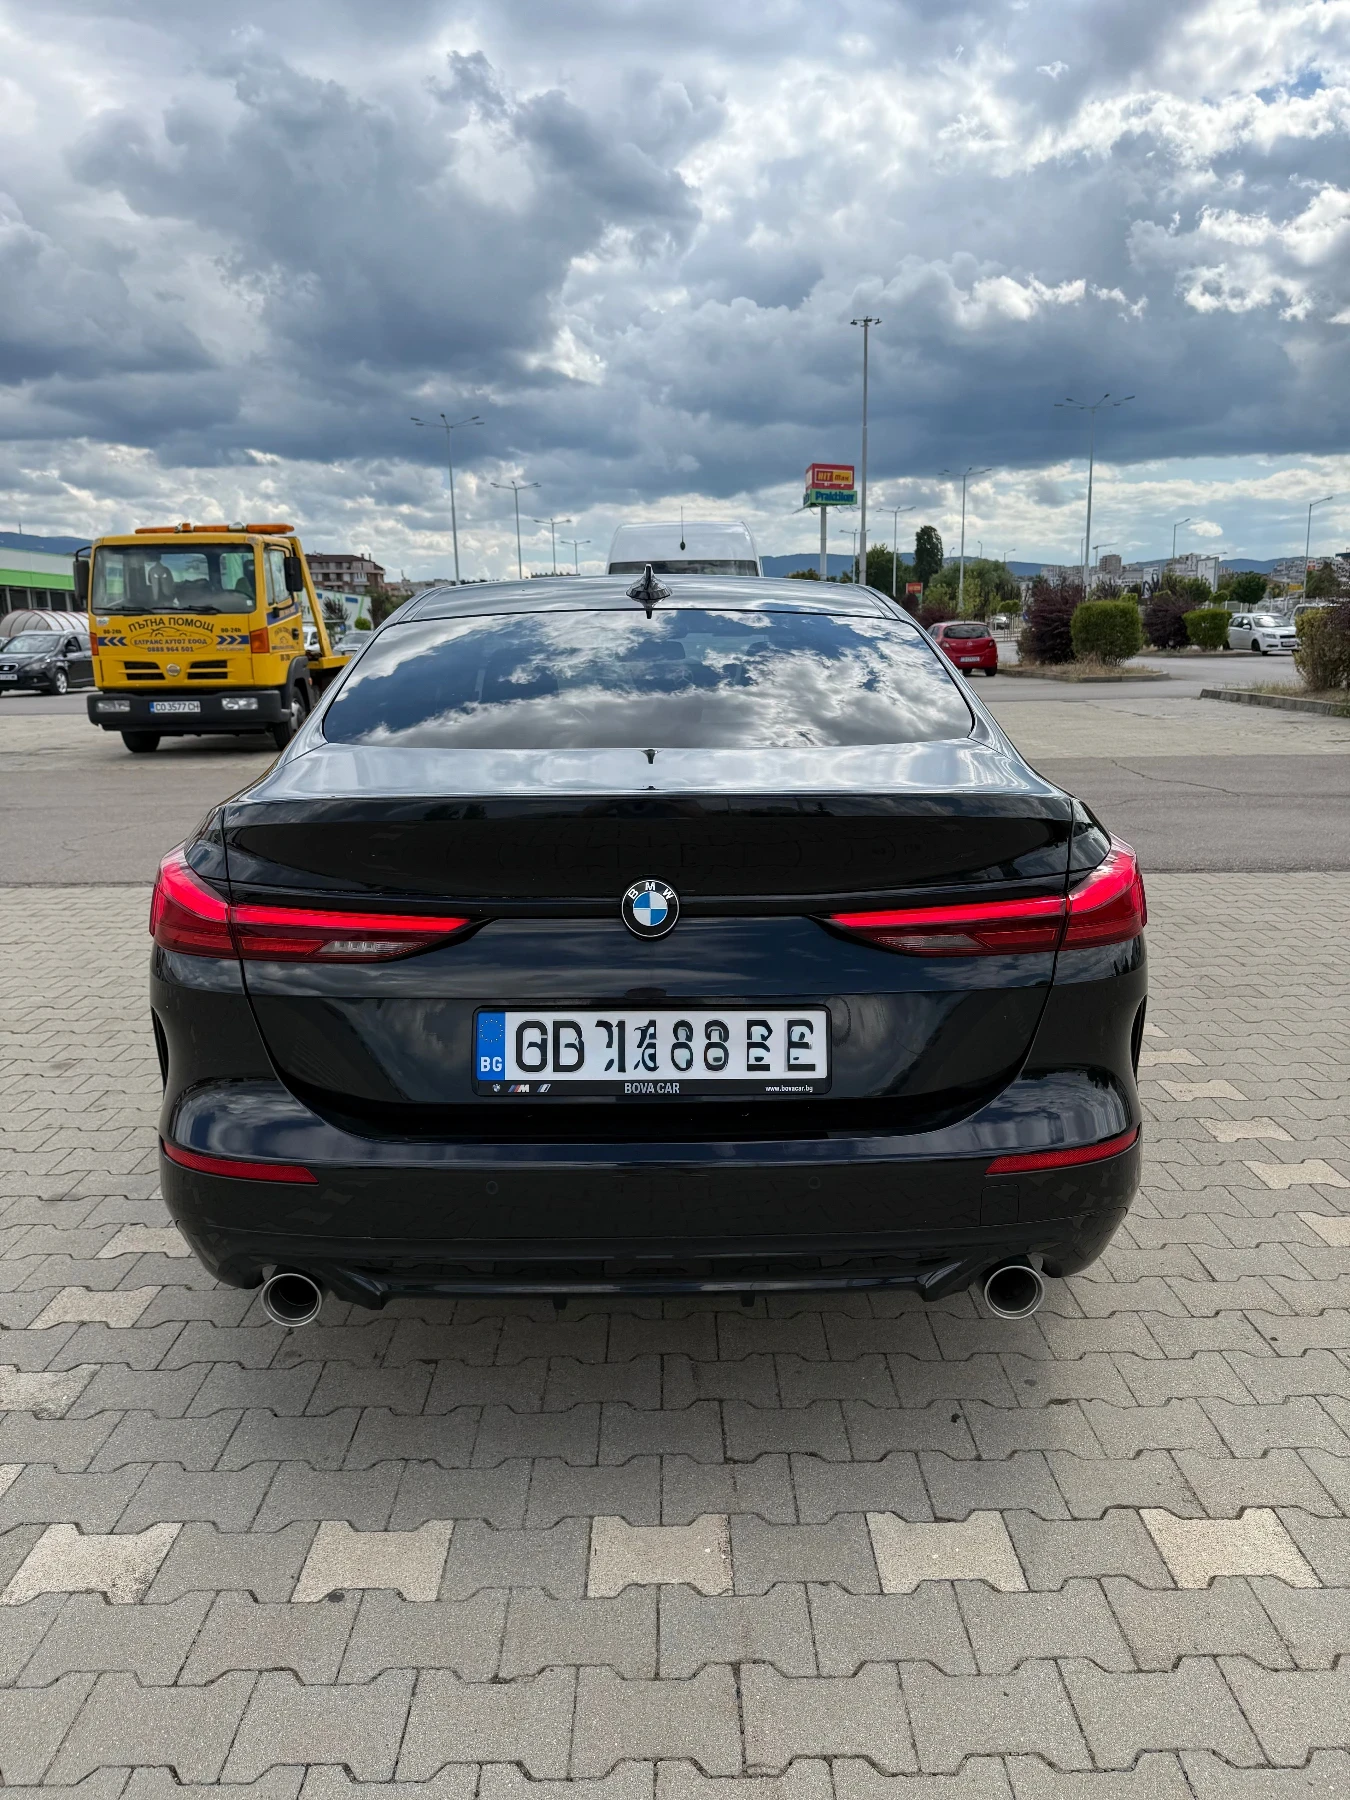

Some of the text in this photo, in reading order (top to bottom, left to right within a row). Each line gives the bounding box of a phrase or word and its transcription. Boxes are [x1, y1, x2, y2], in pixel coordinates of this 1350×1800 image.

[818, 472, 831, 481] HIT
[815, 491, 854, 502] Praktiker
[128, 617, 166, 633] ПЪТНА
[168, 617, 214, 633] ПОМОЩ
[628, 882, 674, 899] BMW
[481, 1057, 502, 1071] BG
[624, 1083, 680, 1093] BOVA CAR
